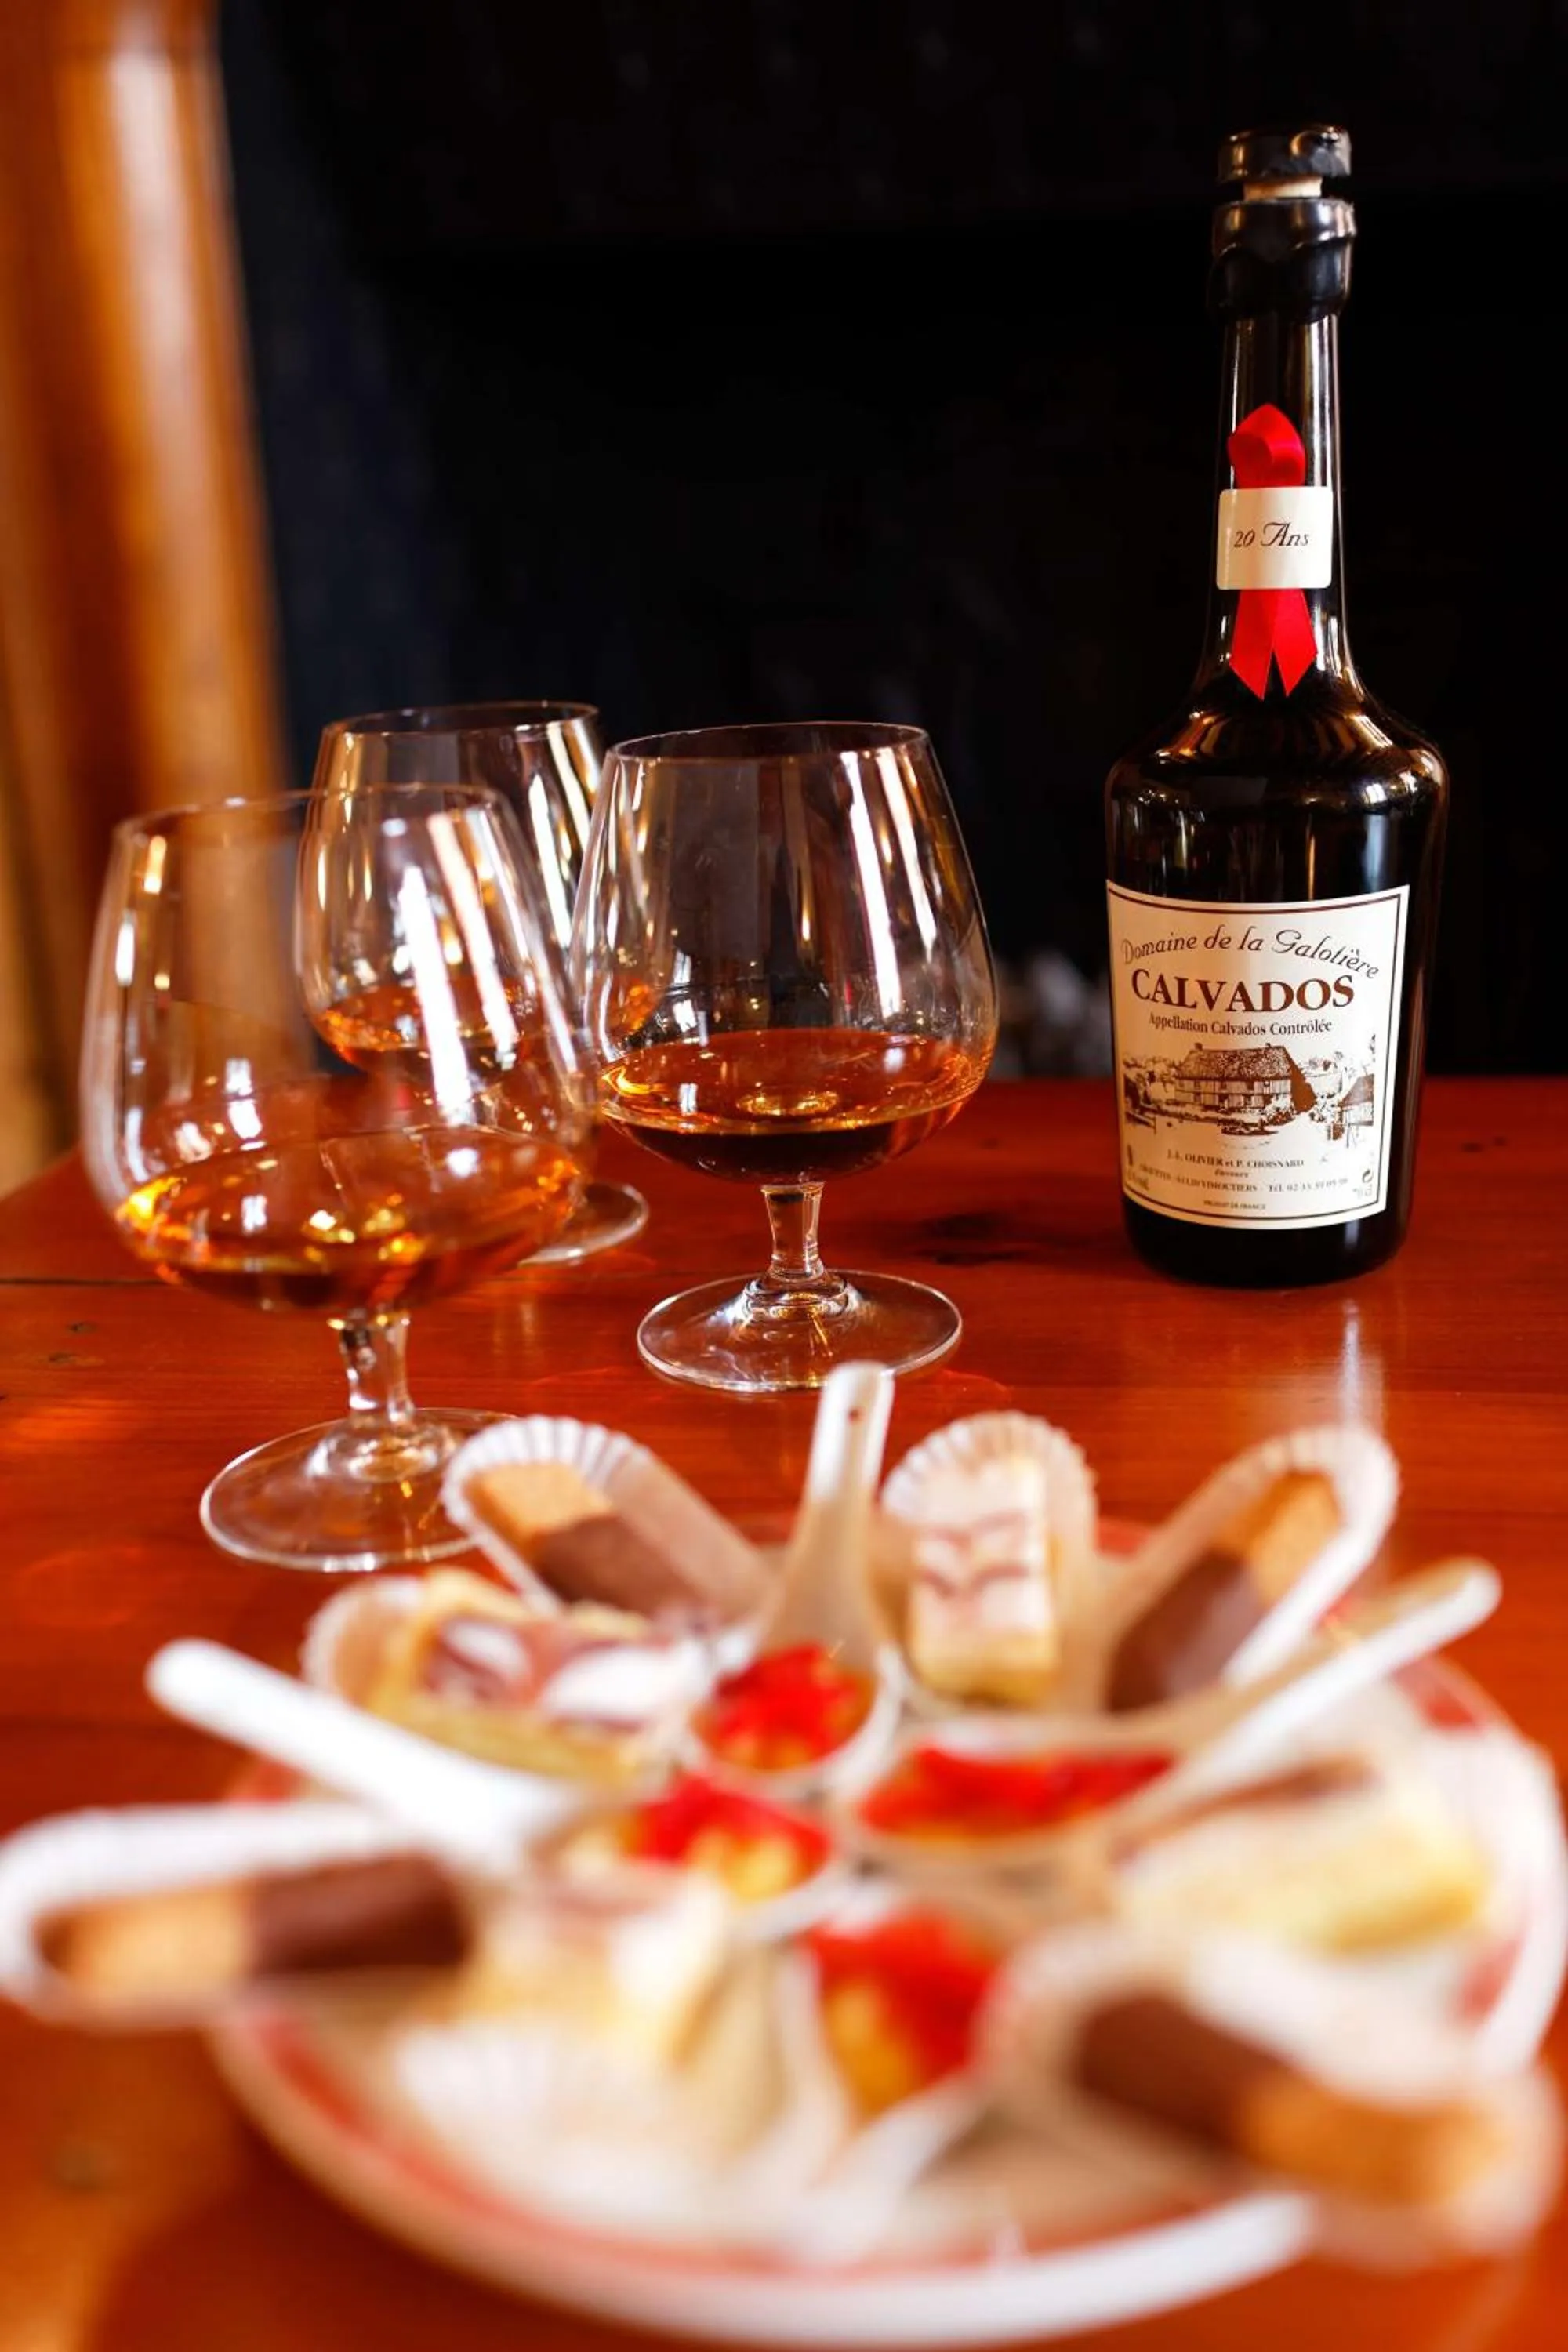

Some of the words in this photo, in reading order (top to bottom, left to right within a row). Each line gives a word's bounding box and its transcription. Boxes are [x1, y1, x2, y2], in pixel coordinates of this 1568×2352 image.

[1233, 530, 1255, 548] 20
[1260, 521, 1309, 547] Ans
[1122, 931, 1197, 964] Domaine
[1203, 924, 1232, 949] de
[1237, 925, 1264, 951] la
[1271, 929, 1379, 978] Galotière
[1131, 968, 1355, 1012] CALVADOS
[1149, 1012, 1208, 1033] Appellation
[1211, 1022, 1266, 1035] Calvados
[1269, 1018, 1332, 1036] Contrôlée
[1185, 1153, 1223, 1167] OLIVIER
